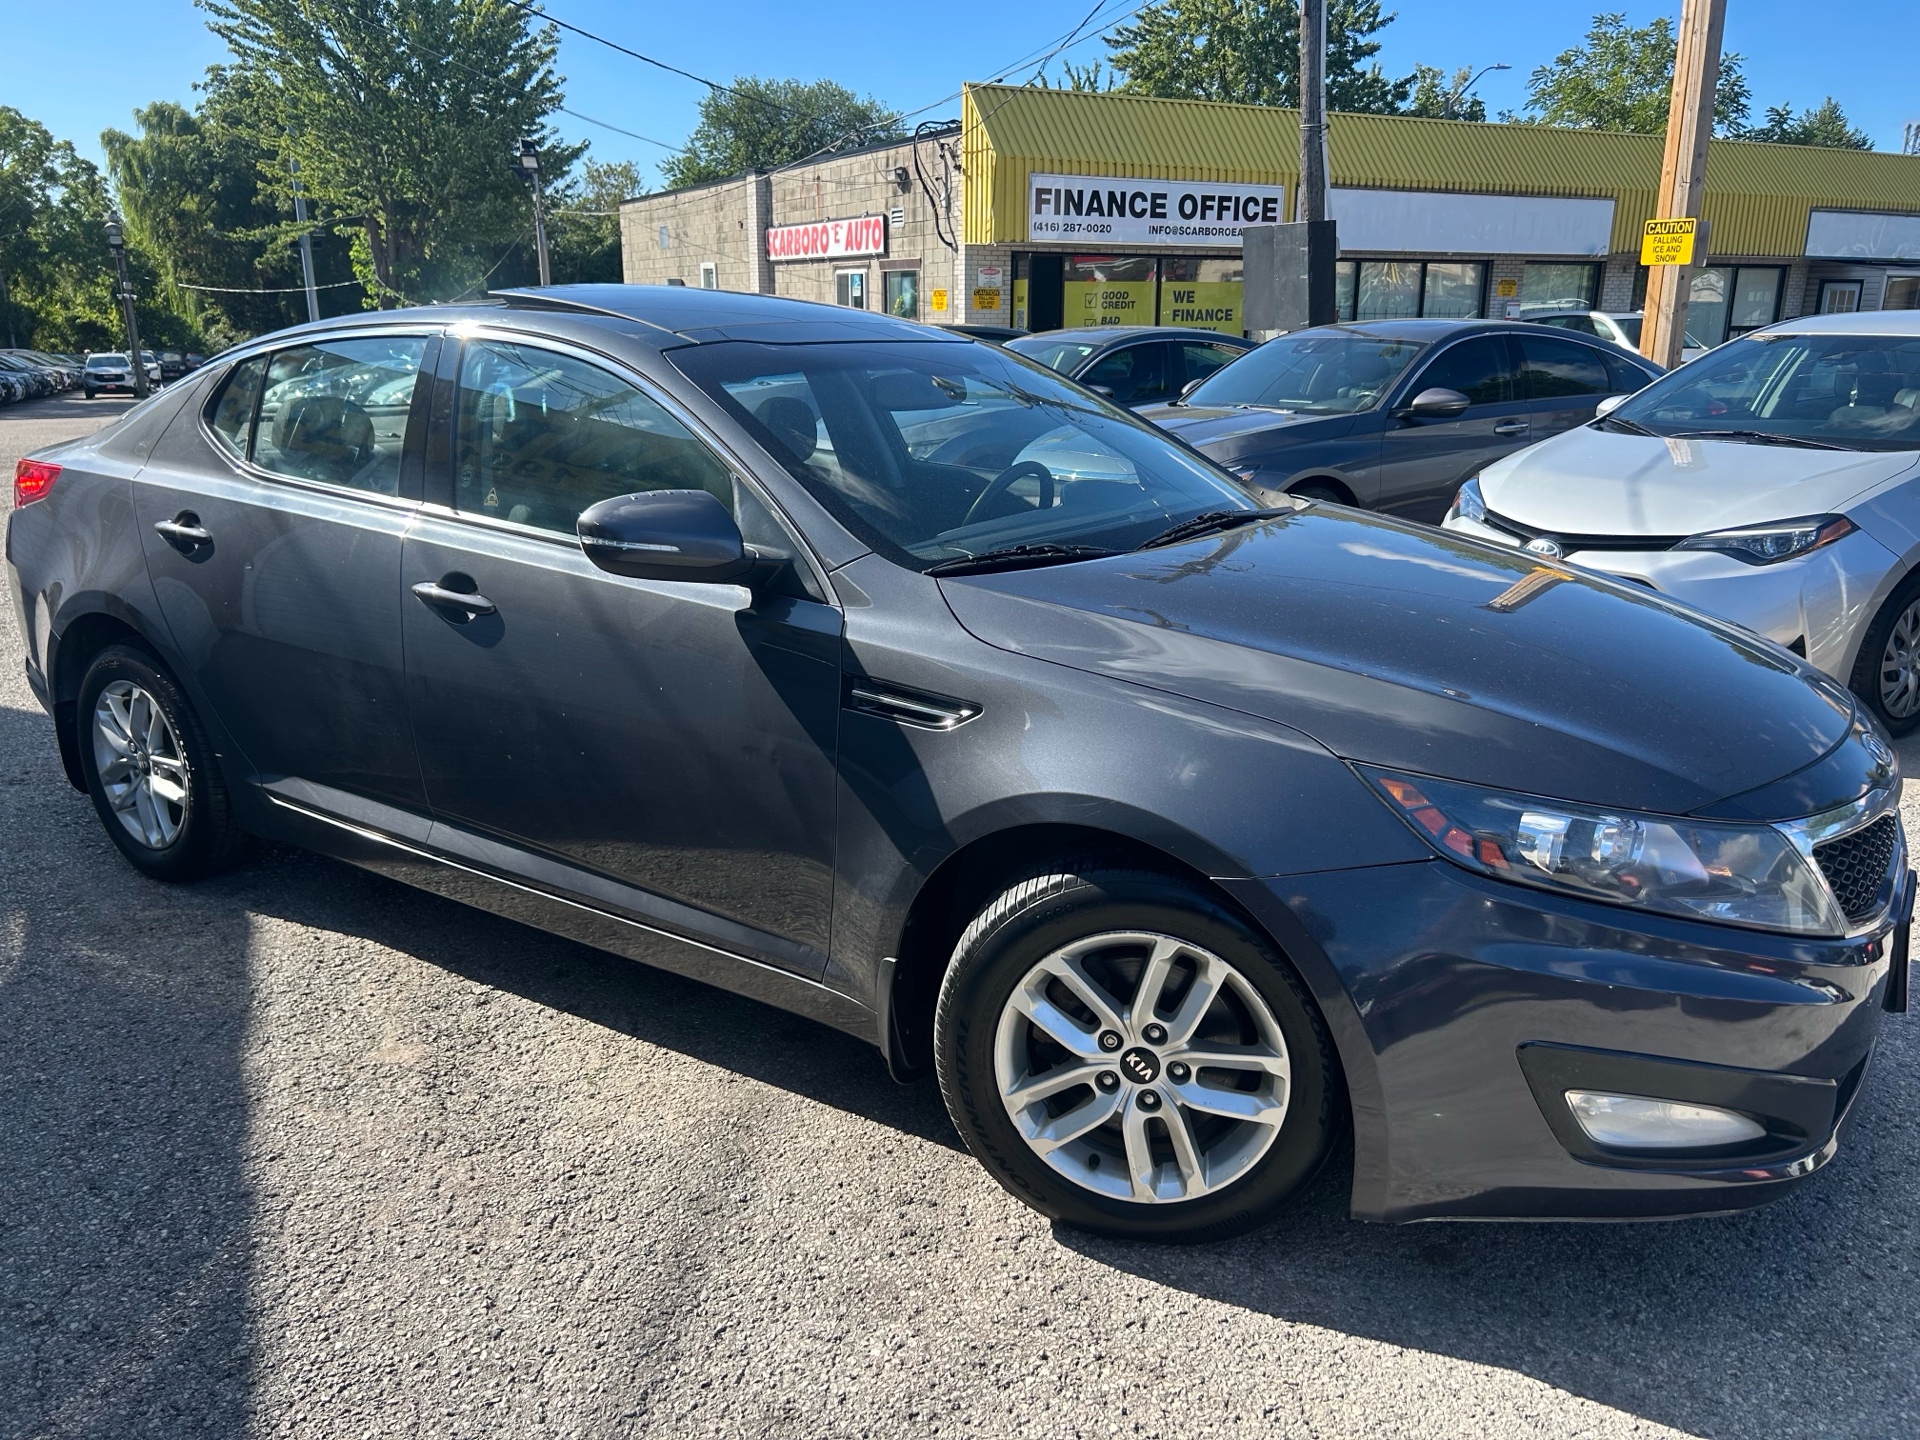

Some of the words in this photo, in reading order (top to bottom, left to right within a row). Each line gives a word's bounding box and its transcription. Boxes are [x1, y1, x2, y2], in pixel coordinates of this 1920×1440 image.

[1034, 188, 1167, 219] FINANCE
[1178, 193, 1278, 223] OFFICE
[1033, 222, 1059, 232] (416)
[1063, 223, 1112, 233] 287-0020
[1148, 225, 1244, 237] INFO@SCARBOROEA
[1647, 221, 1693, 234] CAUTION
[845, 218, 882, 251] AUTO
[1653, 236, 1683, 244] FALLING
[1666, 245, 1681, 253] AND
[1102, 291, 1129, 300] GOOD
[1173, 290, 1195, 304] WE
[1101, 301, 1136, 309] CREDIT
[1101, 317, 1120, 325] BAD
[1172, 309, 1233, 321] FINANCE
[1125, 1051, 1153, 1081] KIA
[955, 1018, 1048, 1202] CONTINENTAL
